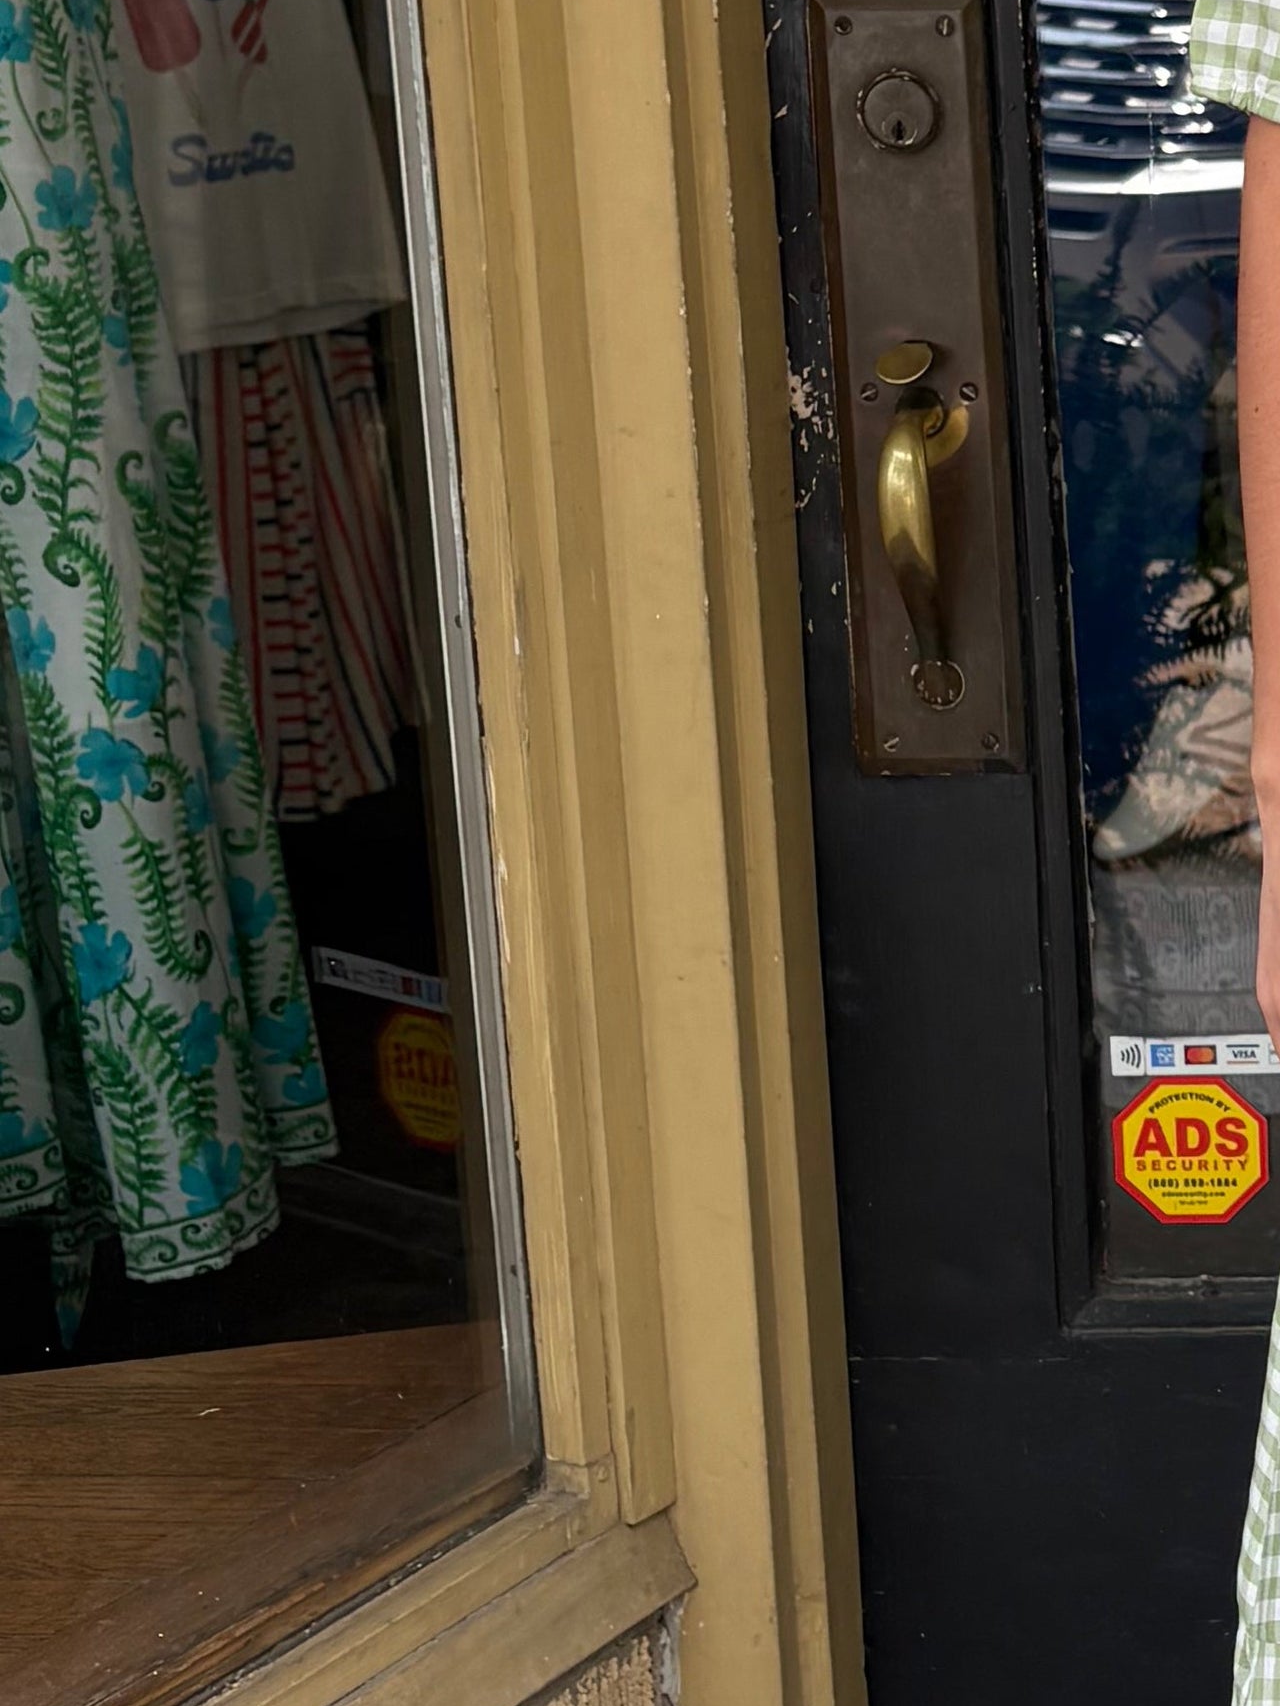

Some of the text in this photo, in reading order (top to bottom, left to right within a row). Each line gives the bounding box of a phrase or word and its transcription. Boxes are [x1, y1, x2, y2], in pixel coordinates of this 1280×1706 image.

[1232, 1050, 1257, 1059] VISA
[1148, 1092, 1232, 1114] PROTECTION BY
[1133, 1117, 1250, 1159] ADS
[1136, 1159, 1249, 1172] SECURITY
